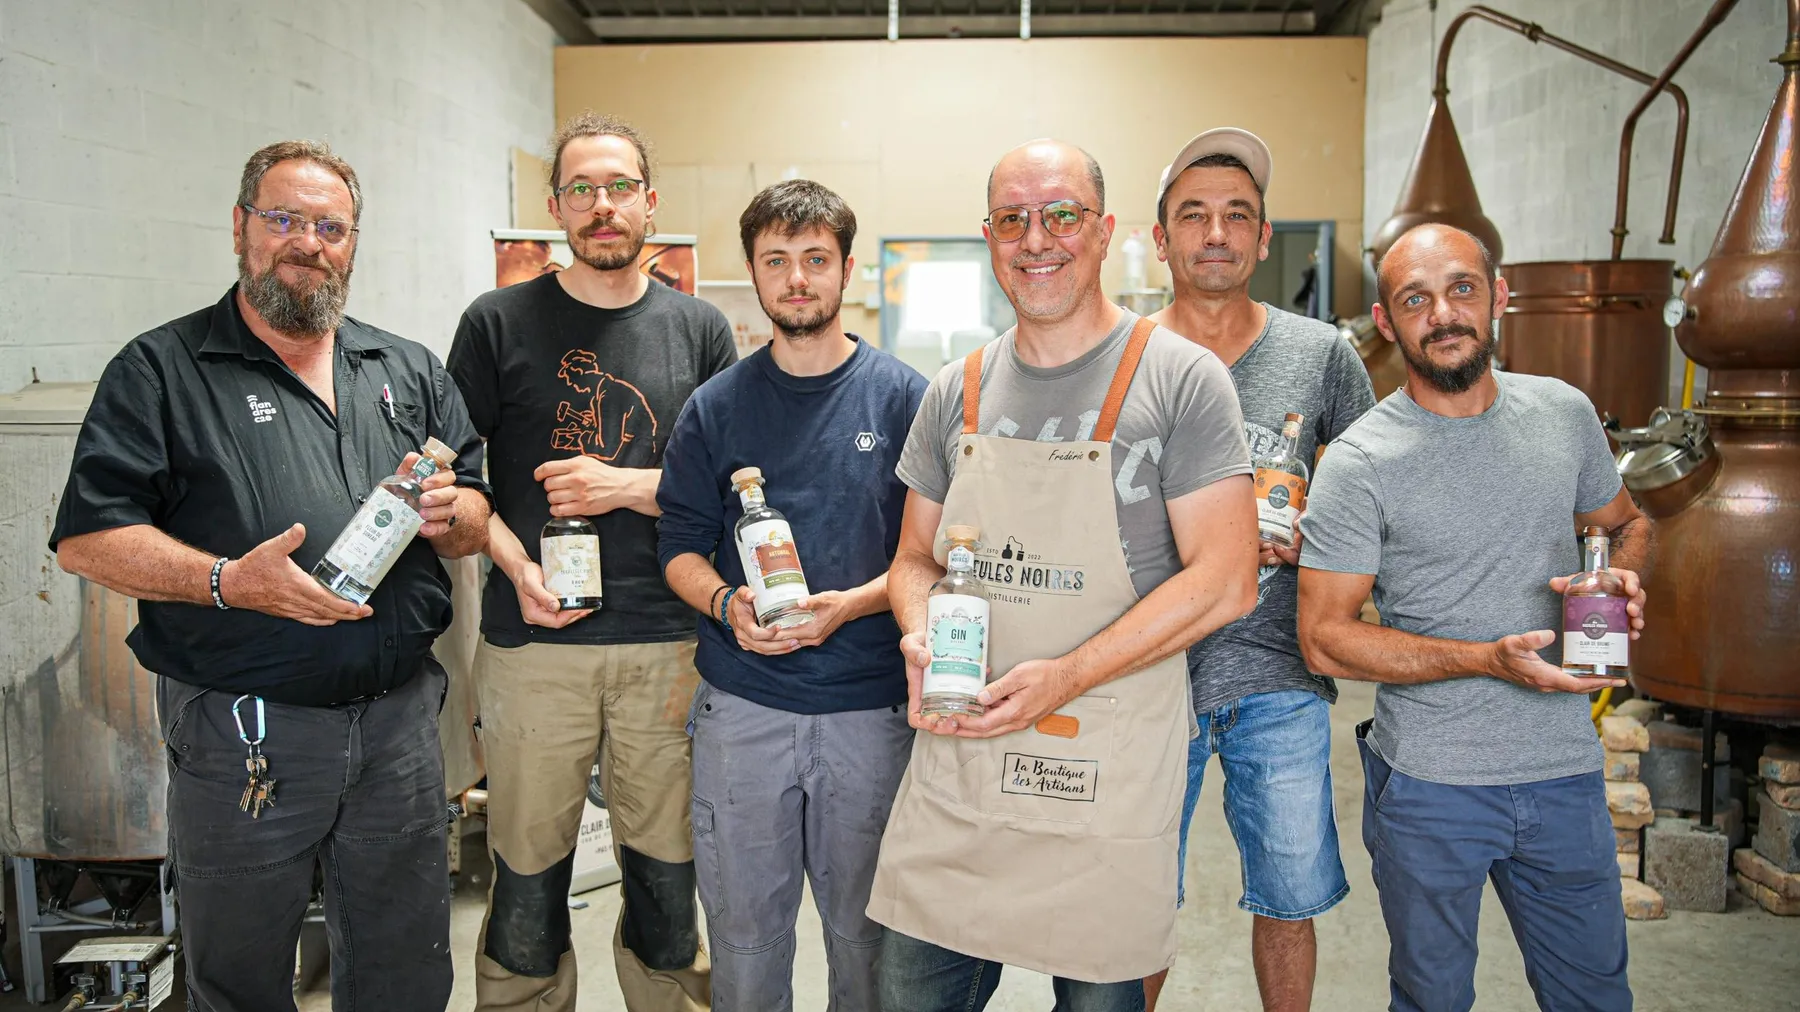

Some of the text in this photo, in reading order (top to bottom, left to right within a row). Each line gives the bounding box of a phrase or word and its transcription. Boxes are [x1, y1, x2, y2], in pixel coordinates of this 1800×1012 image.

[1048, 449, 1084, 461] Frédéric
[973, 559, 1084, 590] EULES NOIRES
[950, 628, 967, 641] GIN
[1014, 757, 1086, 781] La Boutique
[1012, 773, 1086, 794] des Artisans
[581, 819, 603, 836] CLAIR
